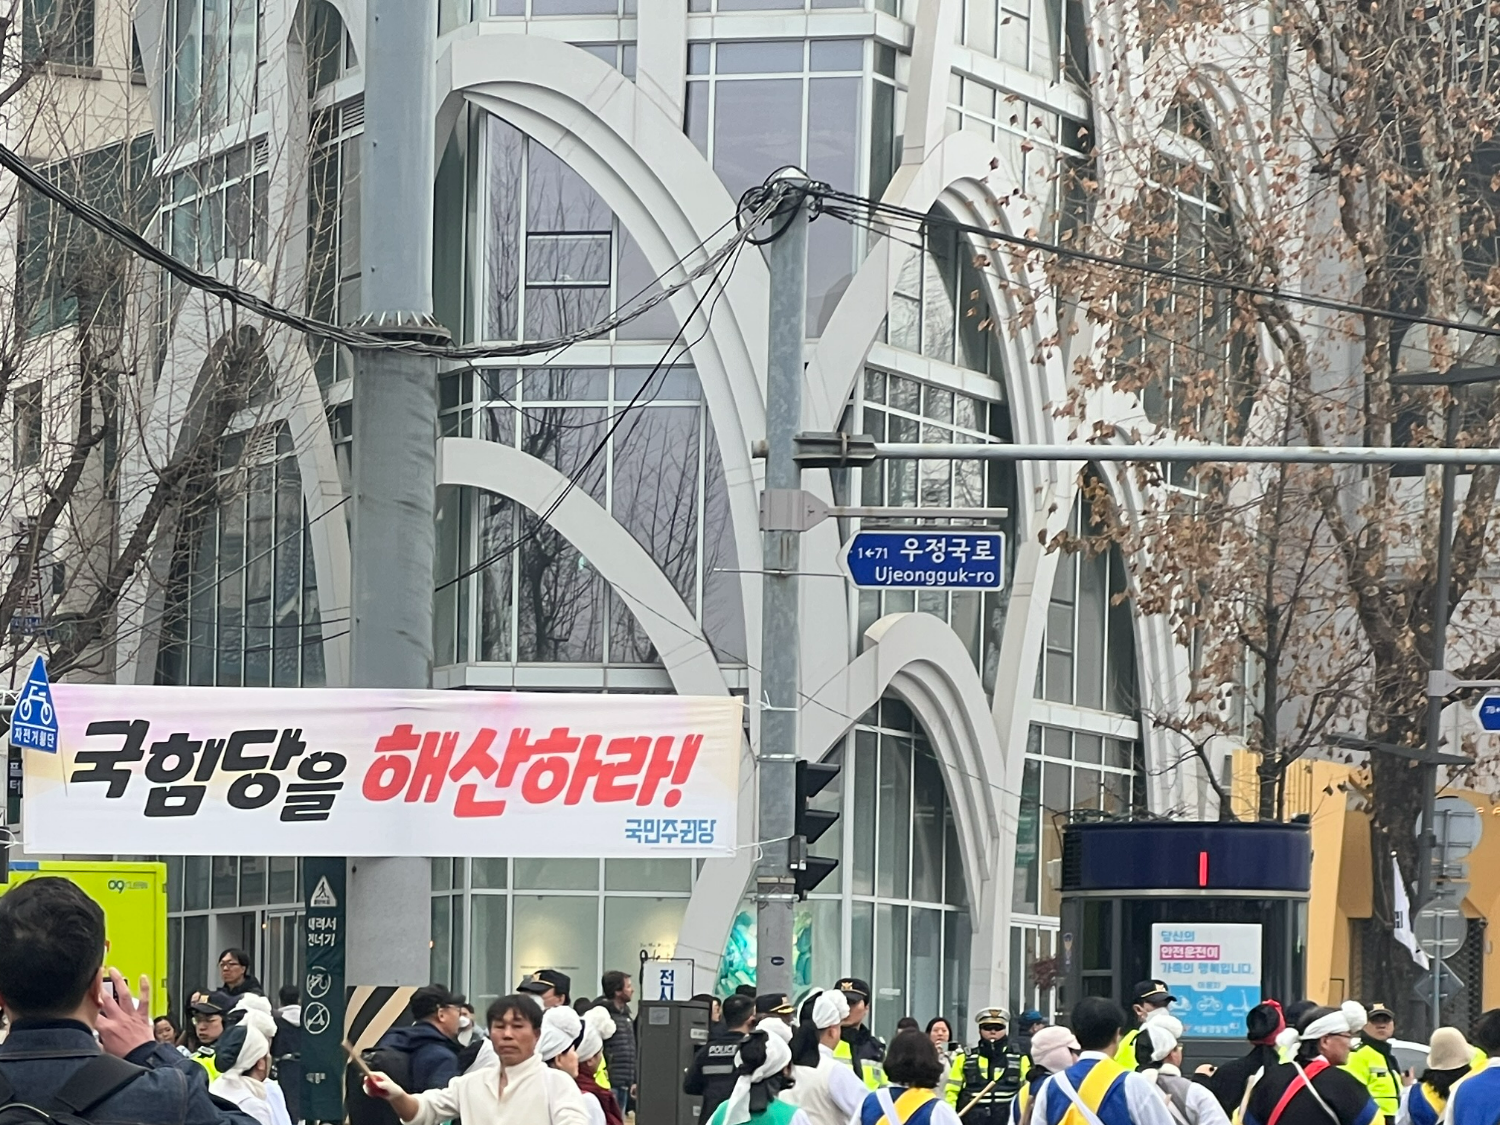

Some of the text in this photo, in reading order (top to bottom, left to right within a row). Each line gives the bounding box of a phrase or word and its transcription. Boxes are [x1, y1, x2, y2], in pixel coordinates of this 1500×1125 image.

[900, 537, 995, 564] 우정국로
[875, 566, 995, 586] Ujeongguk-ro
[14, 727, 55, 748] 자전거횡단
[70, 719, 704, 822] 국힘당을 해산하라!
[625, 819, 717, 844] 국민주권당
[308, 917, 337, 931] 내려서
[308, 933, 336, 947] 건너기
[1161, 931, 1195, 942] 당신의
[1161, 946, 1219, 959] 안전운전이
[1161, 962, 1194, 974] 가족의
